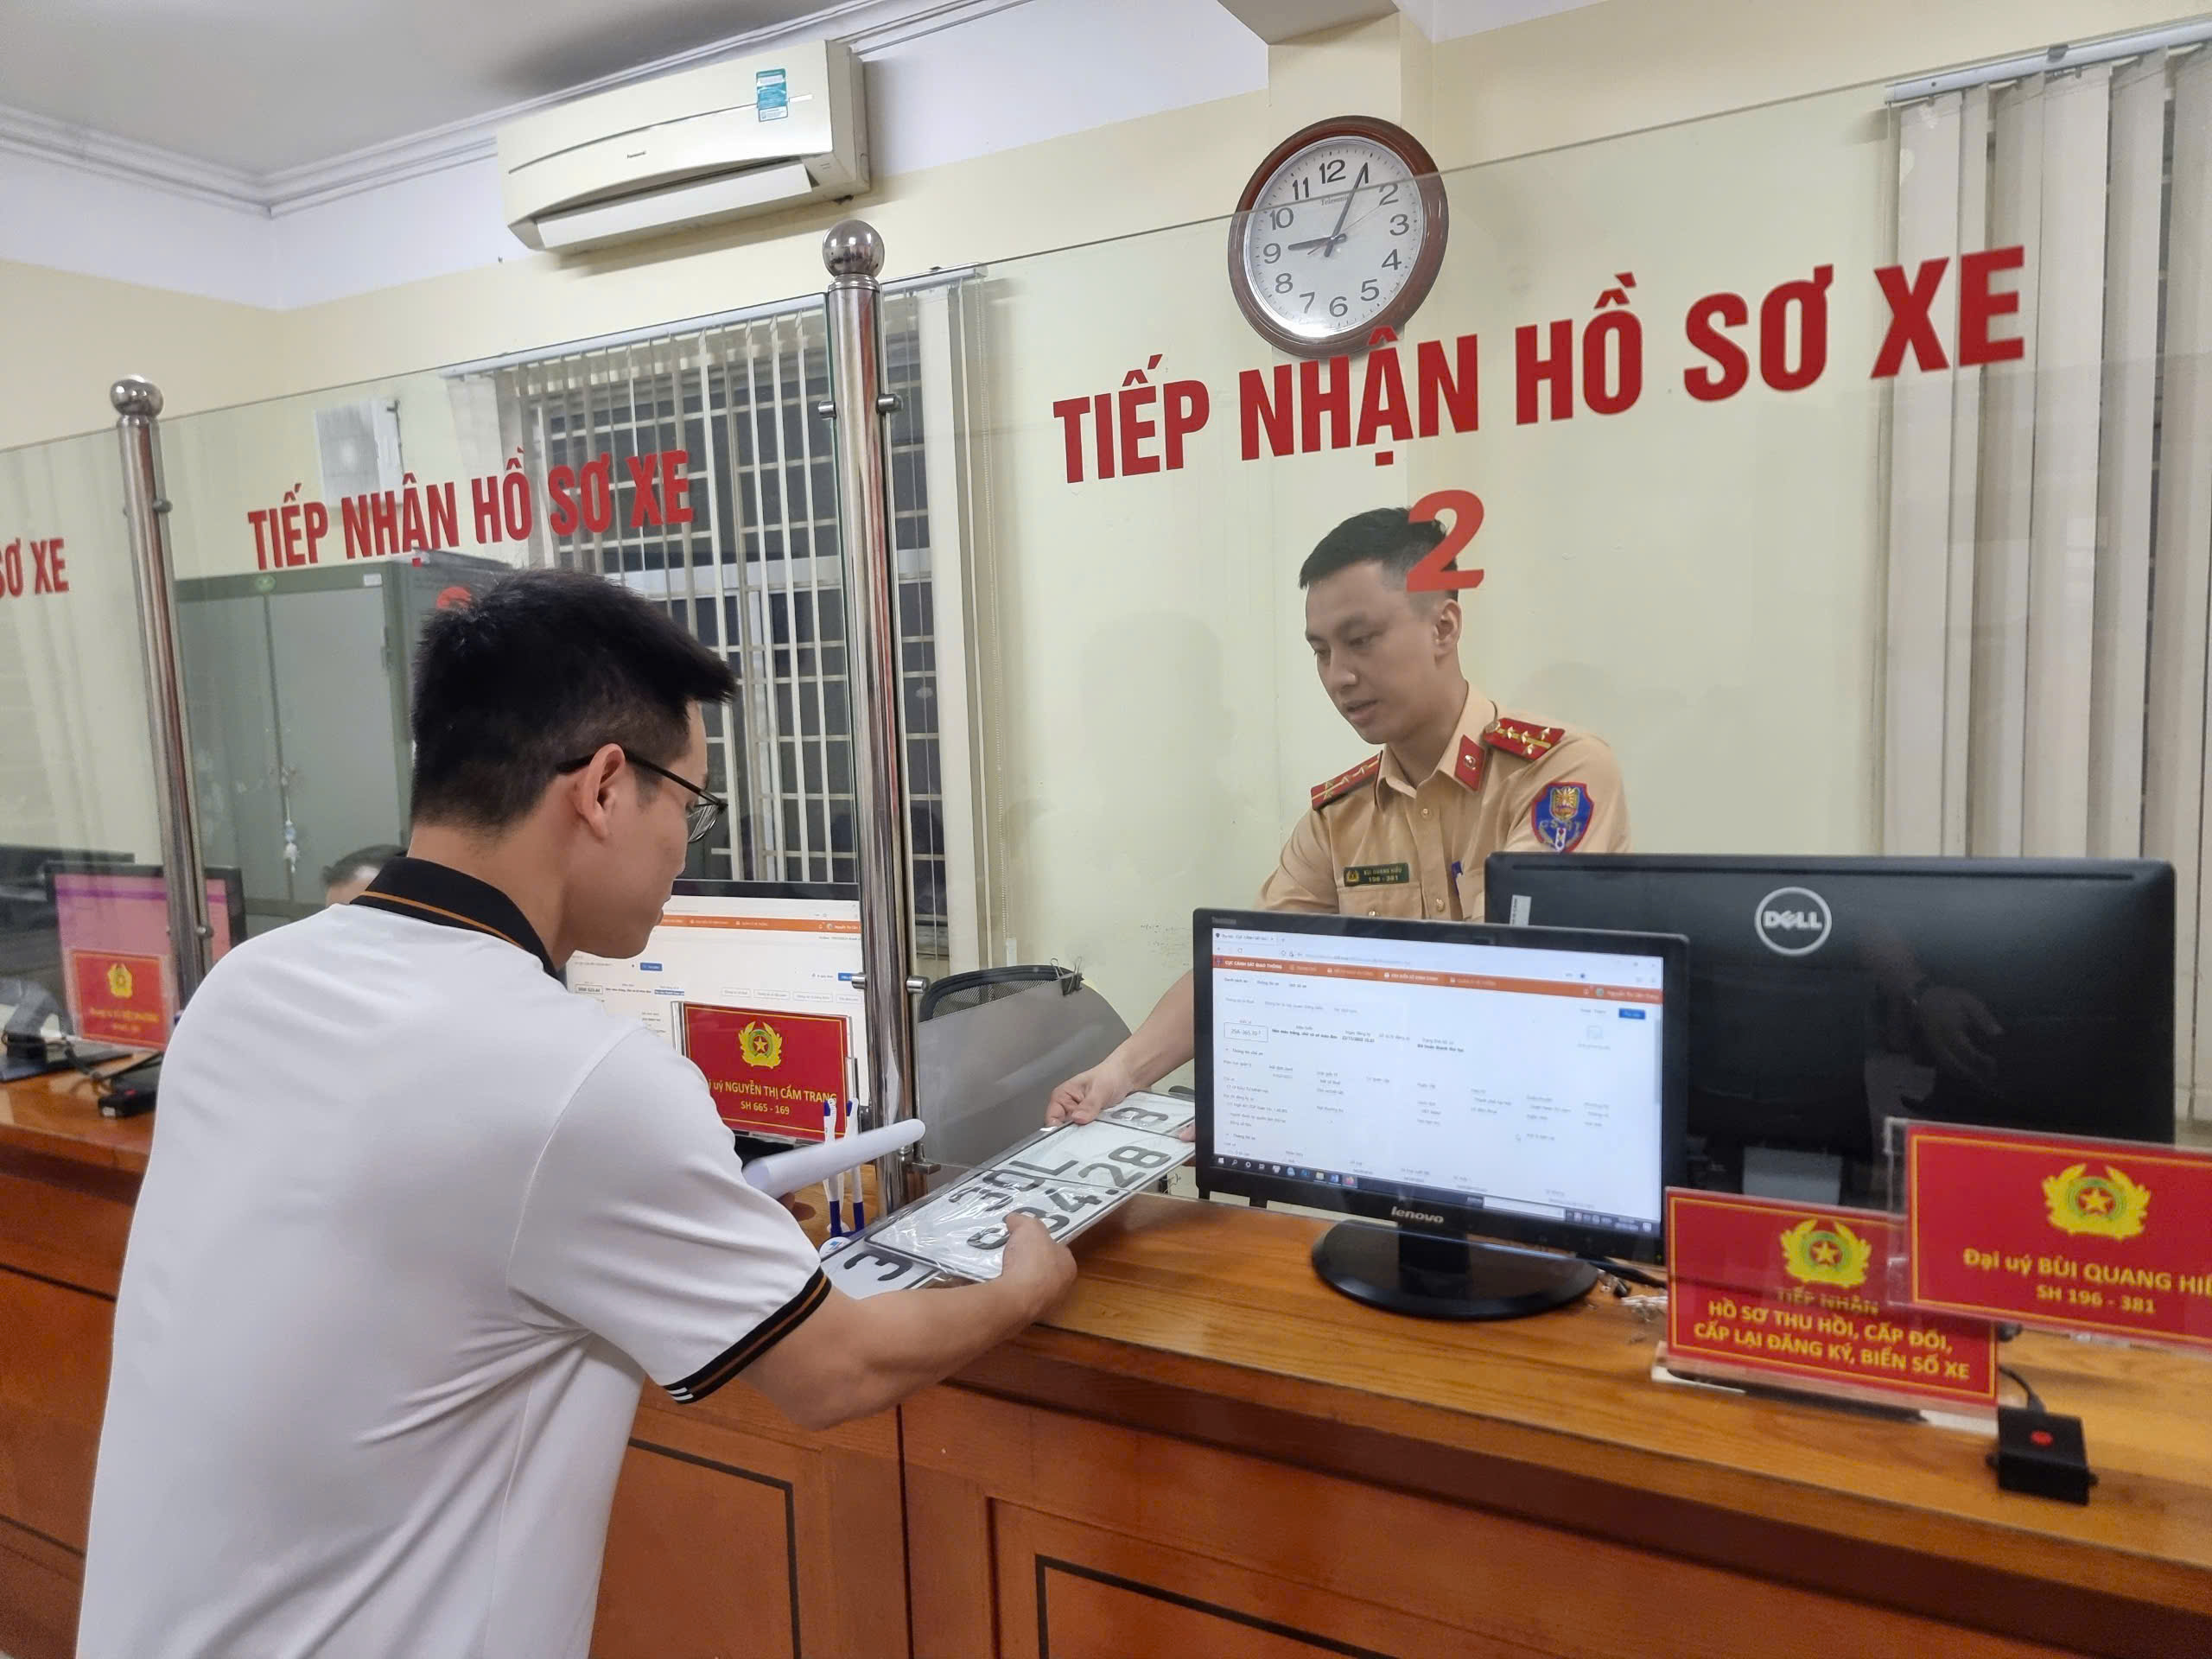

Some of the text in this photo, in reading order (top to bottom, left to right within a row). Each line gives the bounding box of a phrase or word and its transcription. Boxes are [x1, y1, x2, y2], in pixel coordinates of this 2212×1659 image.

[1319, 159, 1346, 185] 12
[1292, 177, 1310, 200] 11
[1378, 183, 1399, 206] 2
[1269, 207, 1294, 231] 10
[1389, 213, 1409, 236] 3
[1262, 243, 1281, 264] 9
[1381, 248, 1402, 270] 4
[1274, 272, 1294, 294] 8
[1360, 278, 1379, 301] 5
[1299, 292, 1315, 314] 7
[1329, 296, 1348, 317] 6
[1054, 246, 2024, 483] TIẾP NHẬN HỒ SƠ XE
[247, 446, 694, 570] TIẾP NHẬN HỒ SƠ XE
[1406, 490, 1484, 593] 2
[29, 538, 69, 594] XE
[1764, 910, 1822, 931] DELL
[714, 1080, 723, 1092] uý
[725, 1080, 761, 1096] NGUYỄN
[764, 1085, 779, 1100] THỊ
[741, 1101, 752, 1110] SH
[753, 1103, 768, 1112] 665
[775, 1105, 790, 1115] 169
[1391, 1205, 1444, 1224] lenovo
[2005, 1254, 2032, 1277] uý
[2037, 1255, 2078, 1279] BÙI
[2083, 1262, 2172, 1292] QUANG
[2037, 1285, 2063, 1301] SH
[2069, 1288, 2102, 1307] 196
[2121, 1295, 2157, 1313] 381
[1708, 1297, 1737, 1319] HỒ
[1742, 1305, 1769, 1322] SƠ
[1774, 1310, 1813, 1330] THU
[1865, 1320, 1904, 1344] CẤP
[1694, 1319, 1730, 1341] CẤP
[1734, 1329, 1763, 1349] LẠI
[1767, 1333, 1823, 1358] ĐĂNG
[1912, 1350, 1940, 1375] SỐ
[1946, 1361, 1970, 1380] XE
